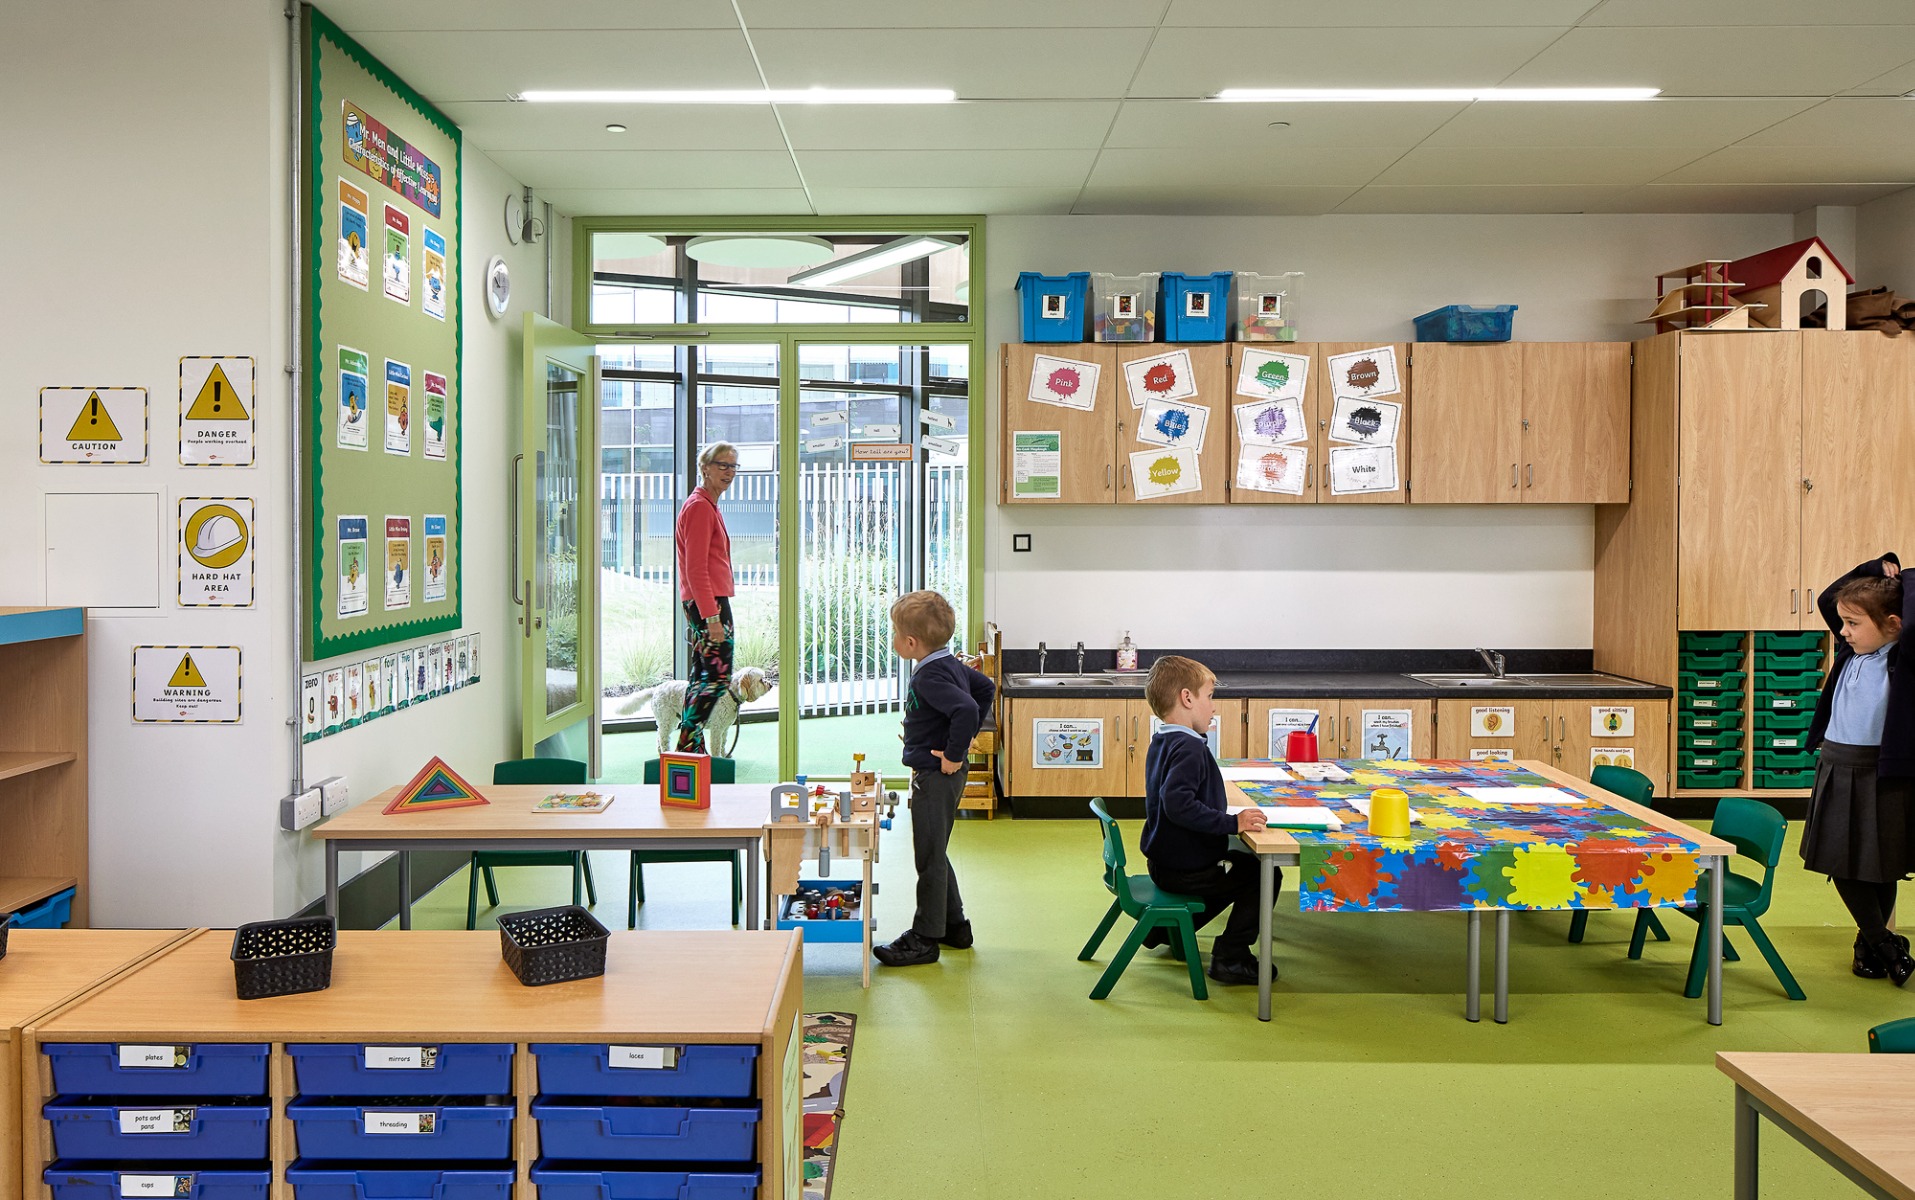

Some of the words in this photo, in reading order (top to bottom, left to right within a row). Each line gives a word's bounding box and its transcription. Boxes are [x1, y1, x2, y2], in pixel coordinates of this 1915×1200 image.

[360, 123, 371, 141] Mr.
[372, 131, 386, 151] Men
[387, 144, 399, 160] and
[400, 151, 415, 171] Little
[1153, 375, 1168, 384] Red
[1261, 370, 1285, 380] Green
[1351, 370, 1377, 381] Brown
[1055, 378, 1073, 387] Pink
[1164, 419, 1182, 430] Blue
[1354, 416, 1377, 427] Black
[197, 430, 237, 438] DANGER
[1152, 468, 1179, 477] Yellow
[1352, 465, 1376, 473] White
[384, 658, 395, 668] four
[328, 672, 339, 683] one
[304, 678, 319, 689] zero
[163, 689, 211, 697] WARNING
[145, 1053, 163, 1062] plates
[388, 1054, 411, 1063] mirrors
[629, 1052, 644, 1060] laces
[135, 1114, 148, 1122] pots
[141, 1123, 155, 1131] pans
[379, 1120, 408, 1129] threading
